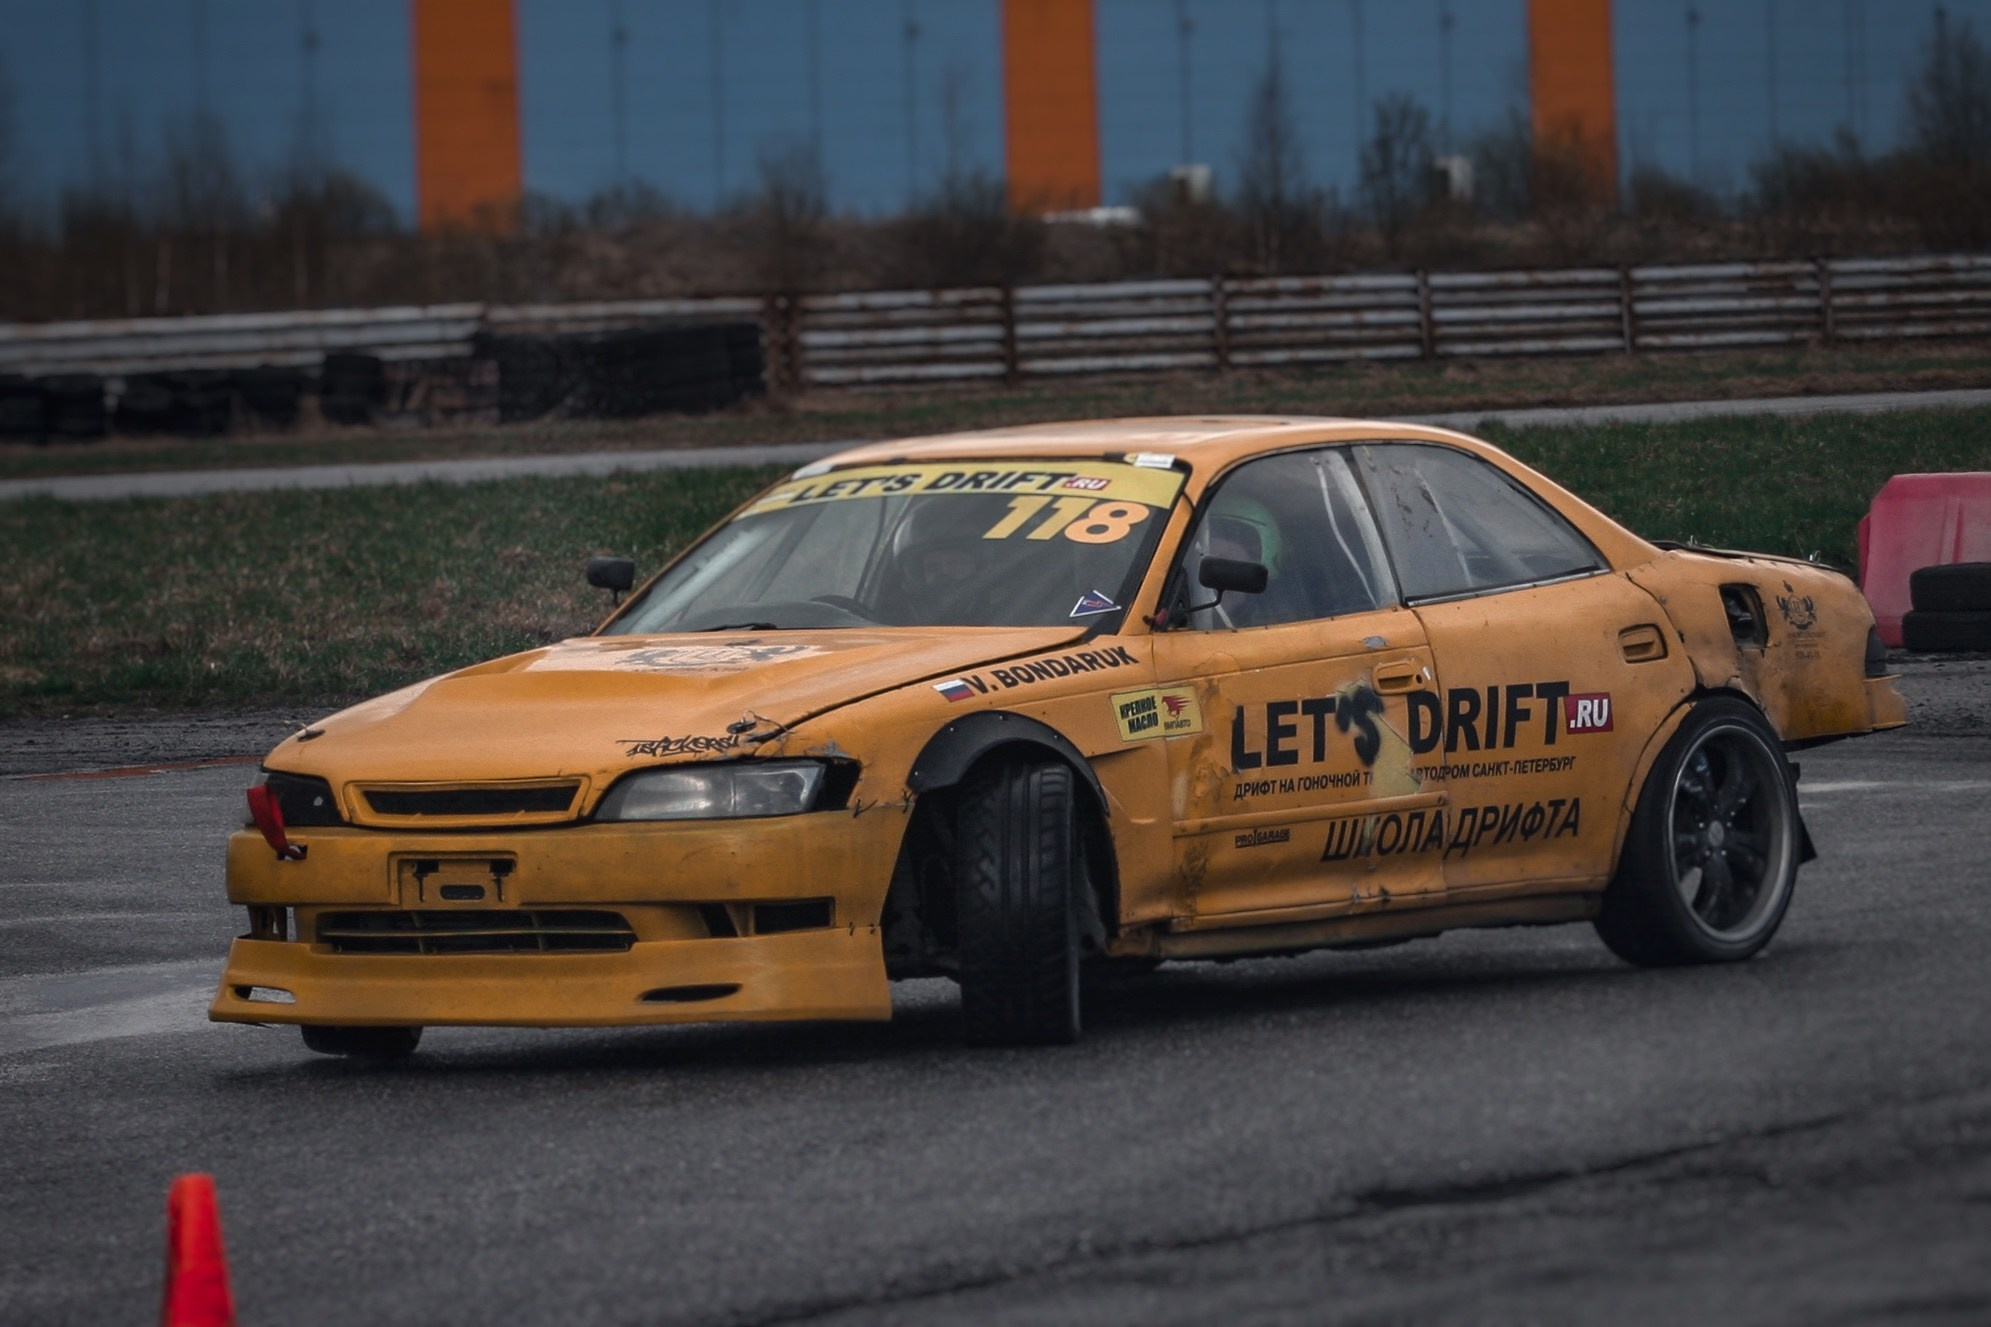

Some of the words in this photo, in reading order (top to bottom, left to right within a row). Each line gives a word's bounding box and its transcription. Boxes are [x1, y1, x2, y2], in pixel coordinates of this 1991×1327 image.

[797, 472, 925, 500] LET'S
[922, 471, 1077, 494] DRIFT
[981, 496, 1150, 544] 118
[1128, 712, 1159, 734] МАСЛО
[1231, 687, 1386, 770] LET'S
[1406, 681, 1570, 754] DRIFT
[1234, 780, 1277, 800] ДРИФТ
[1279, 778, 1295, 793] НА
[1297, 769, 1360, 792] ГОНОЧНОЙ
[1472, 756, 1576, 778] САНКТ-ПЕТЕРБУРГ
[1441, 796, 1581, 861] ДРИФТА
